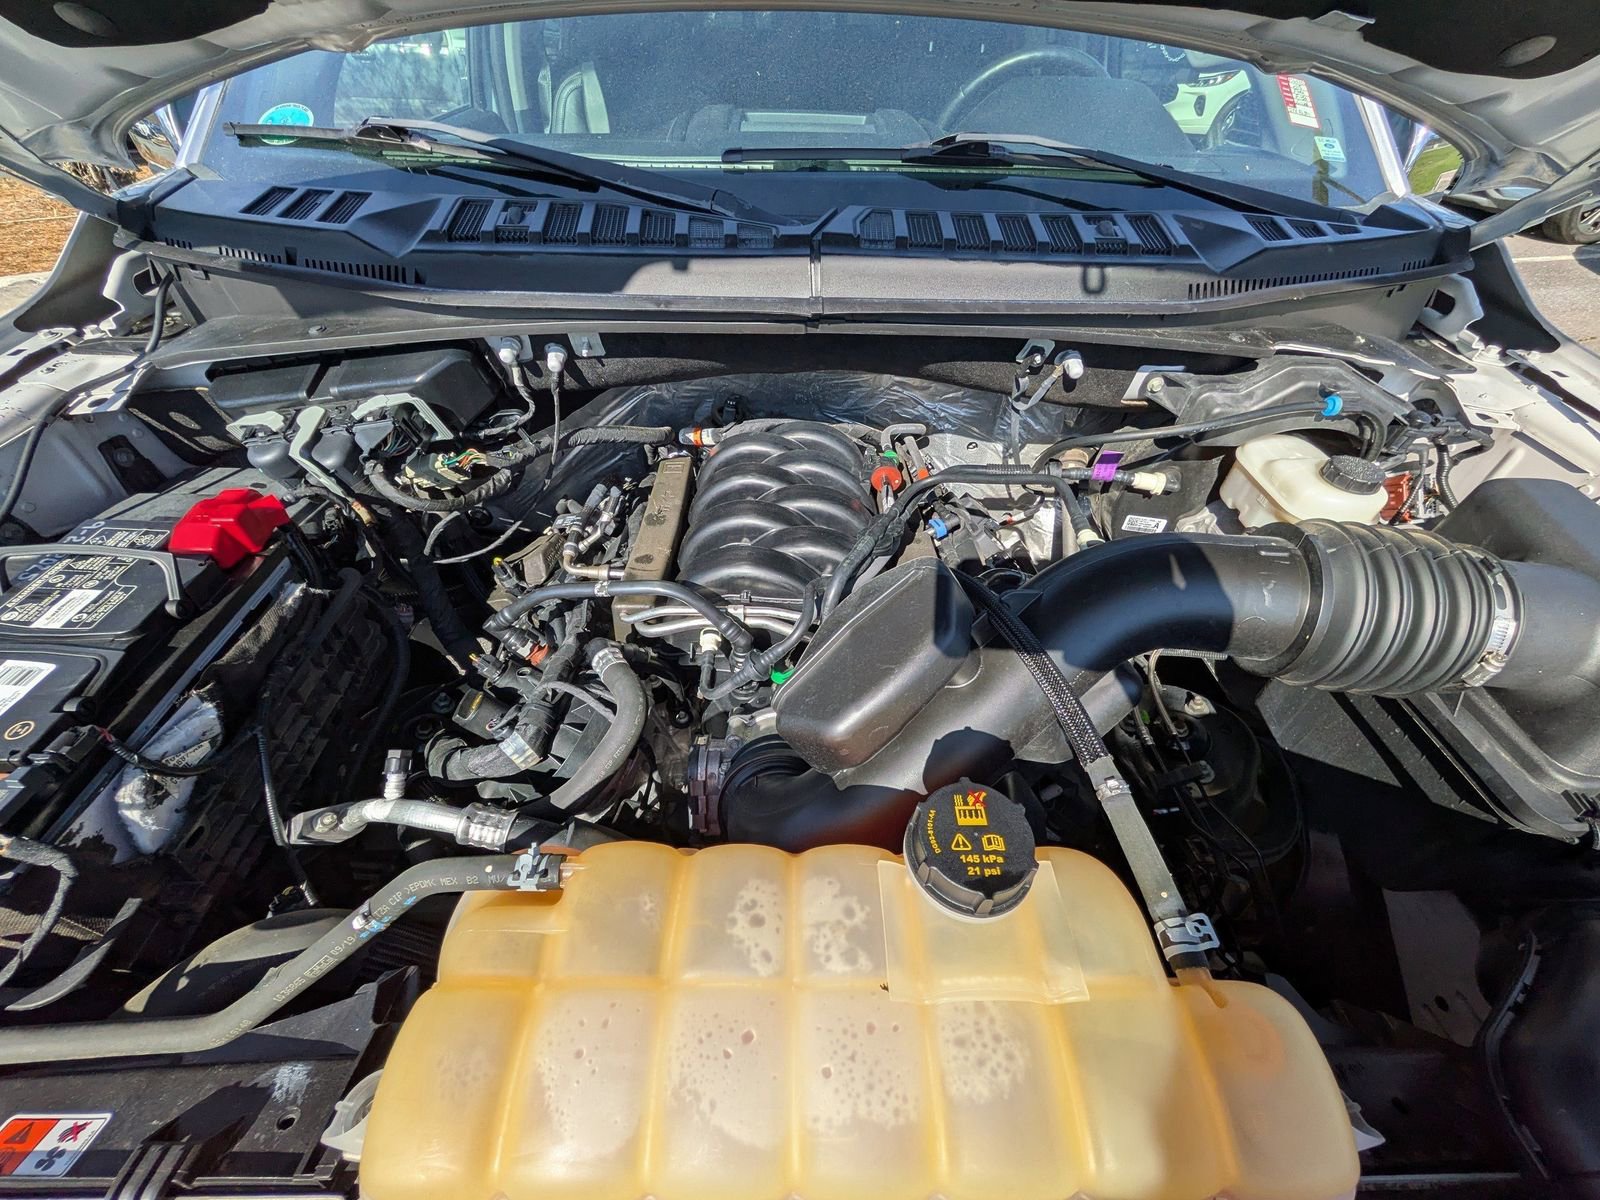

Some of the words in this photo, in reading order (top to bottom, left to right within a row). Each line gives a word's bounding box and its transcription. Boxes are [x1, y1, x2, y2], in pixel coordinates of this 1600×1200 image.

[960, 854, 980, 864] 145
[983, 854, 1004, 864] kPa
[967, 867, 980, 876] 21
[984, 866, 1001, 878] psi
[440, 877, 457, 887] MEX
